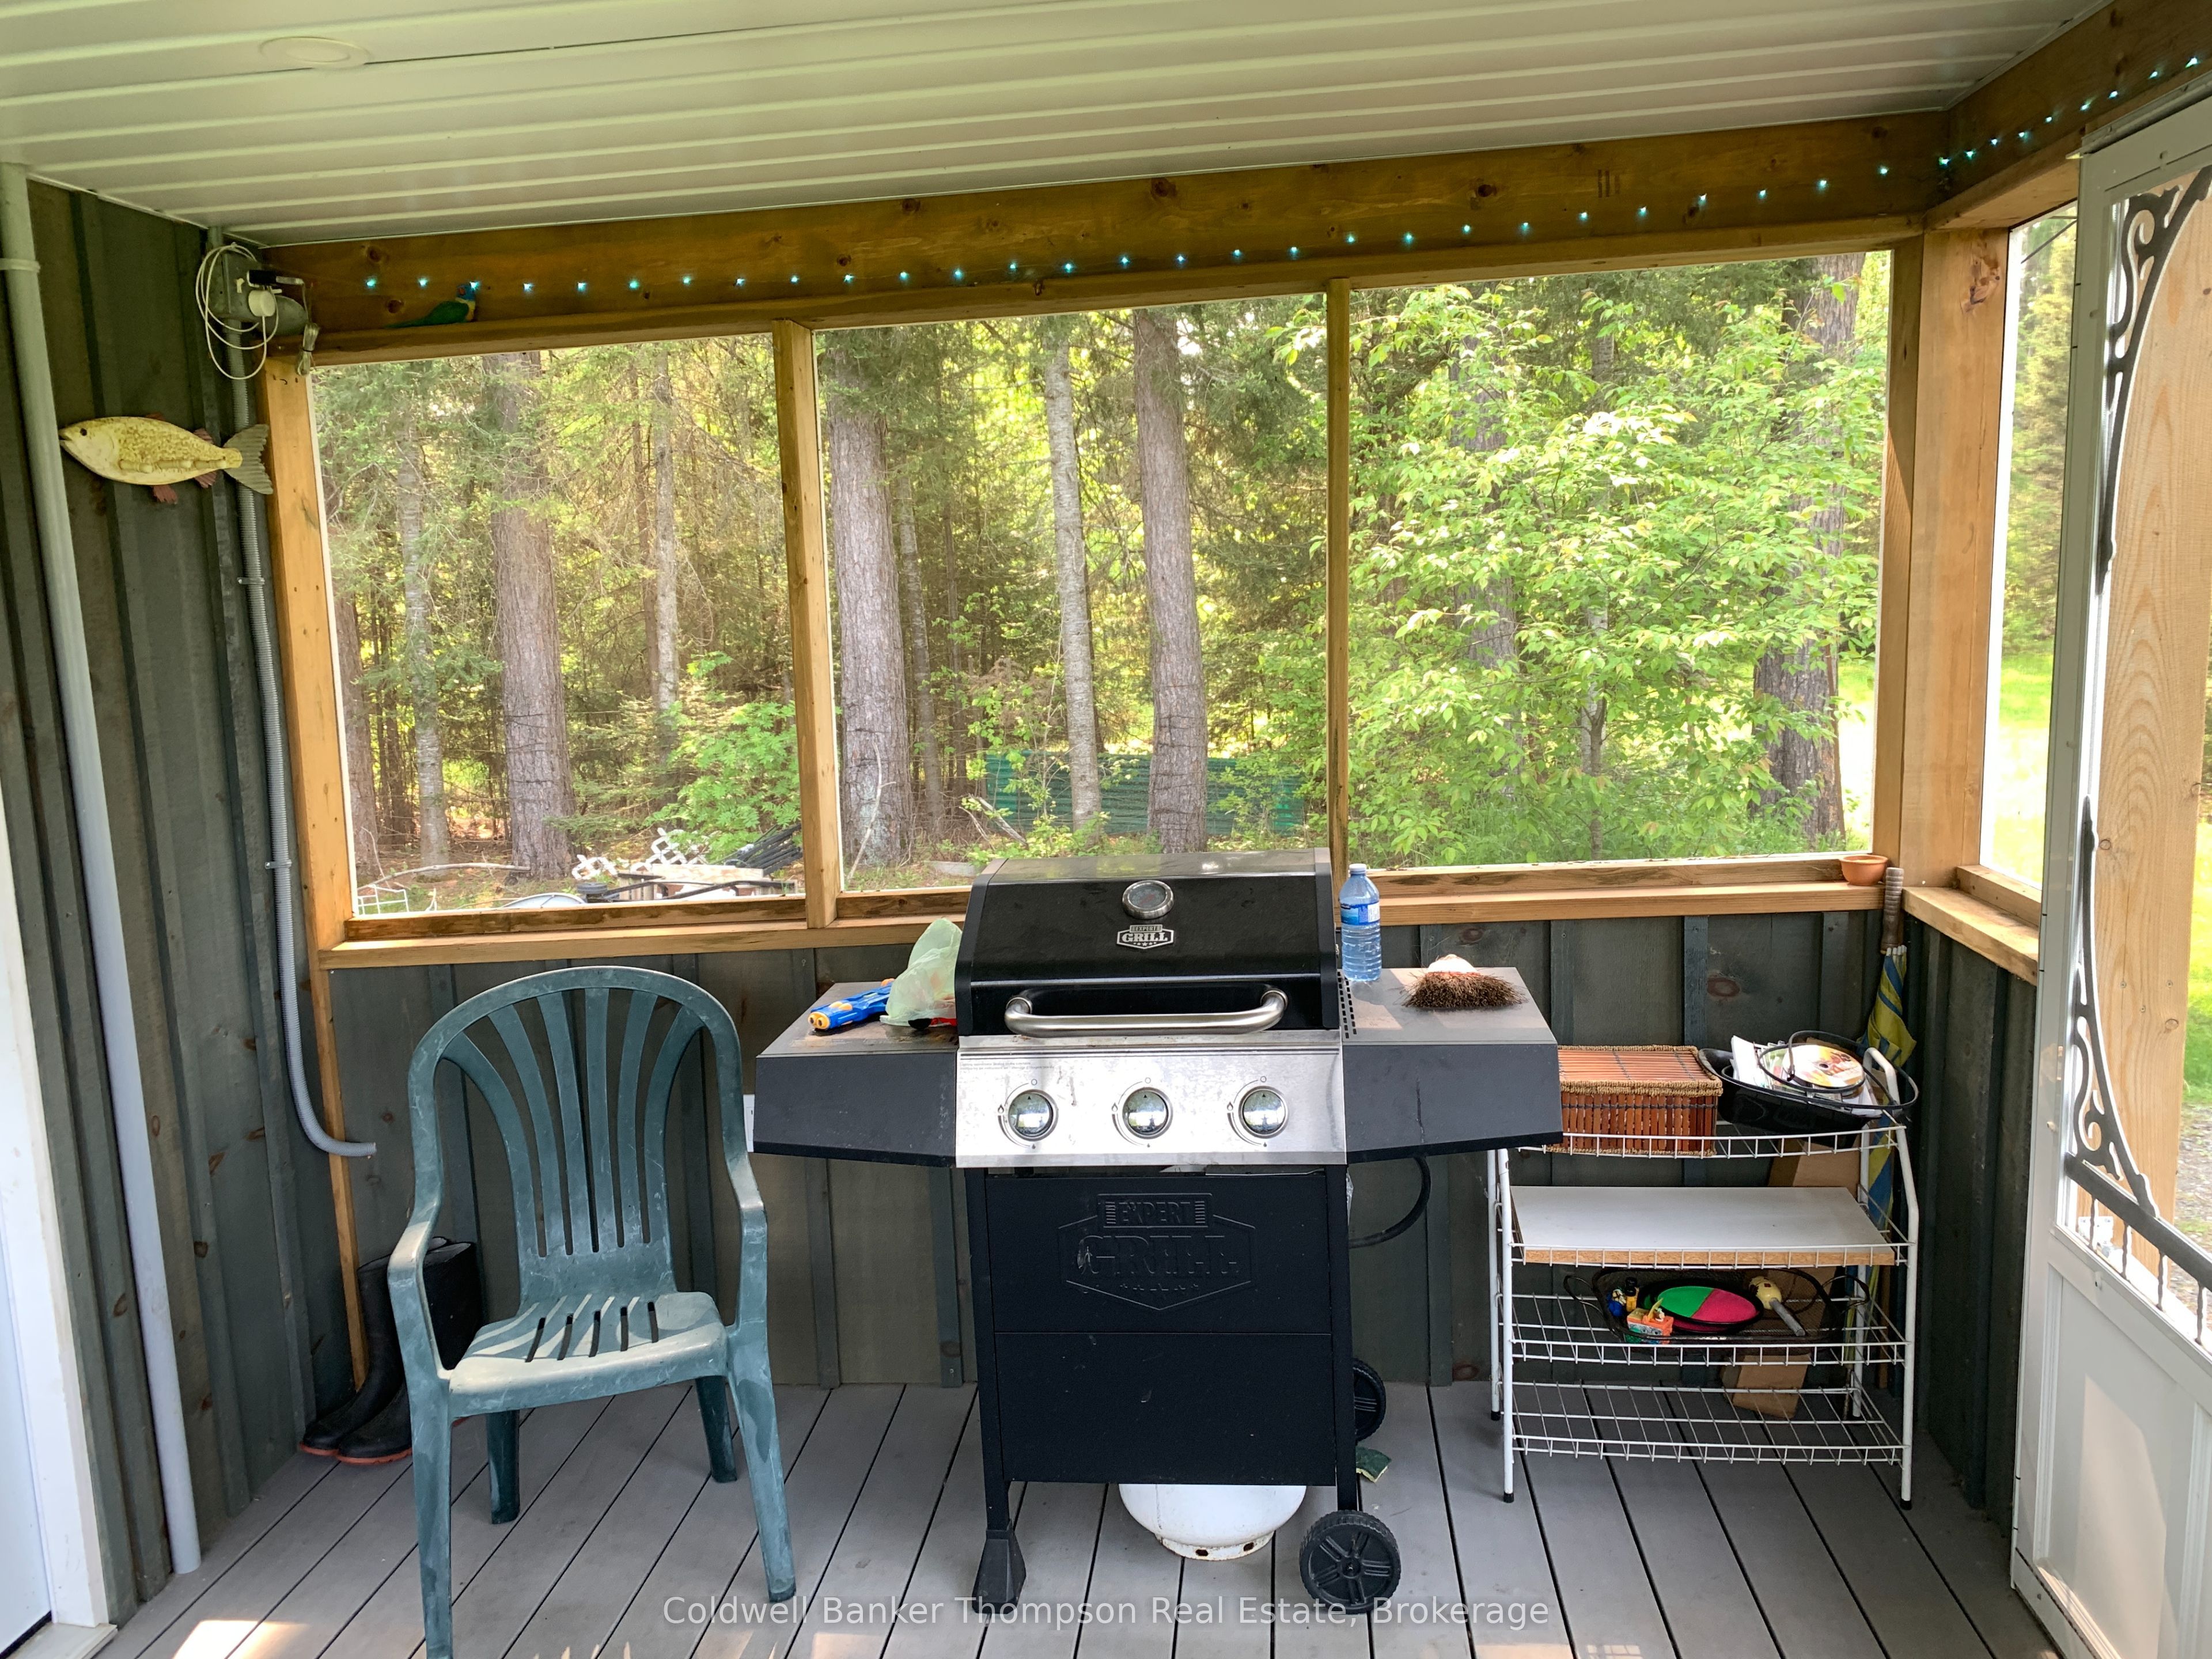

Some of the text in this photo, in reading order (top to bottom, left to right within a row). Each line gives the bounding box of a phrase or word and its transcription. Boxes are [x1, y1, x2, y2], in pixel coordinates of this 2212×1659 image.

[1122, 932, 1168, 942] GRILL
[1119, 1201, 1191, 1224] EXPERT
[1076, 1234, 1240, 1274] GRILL
